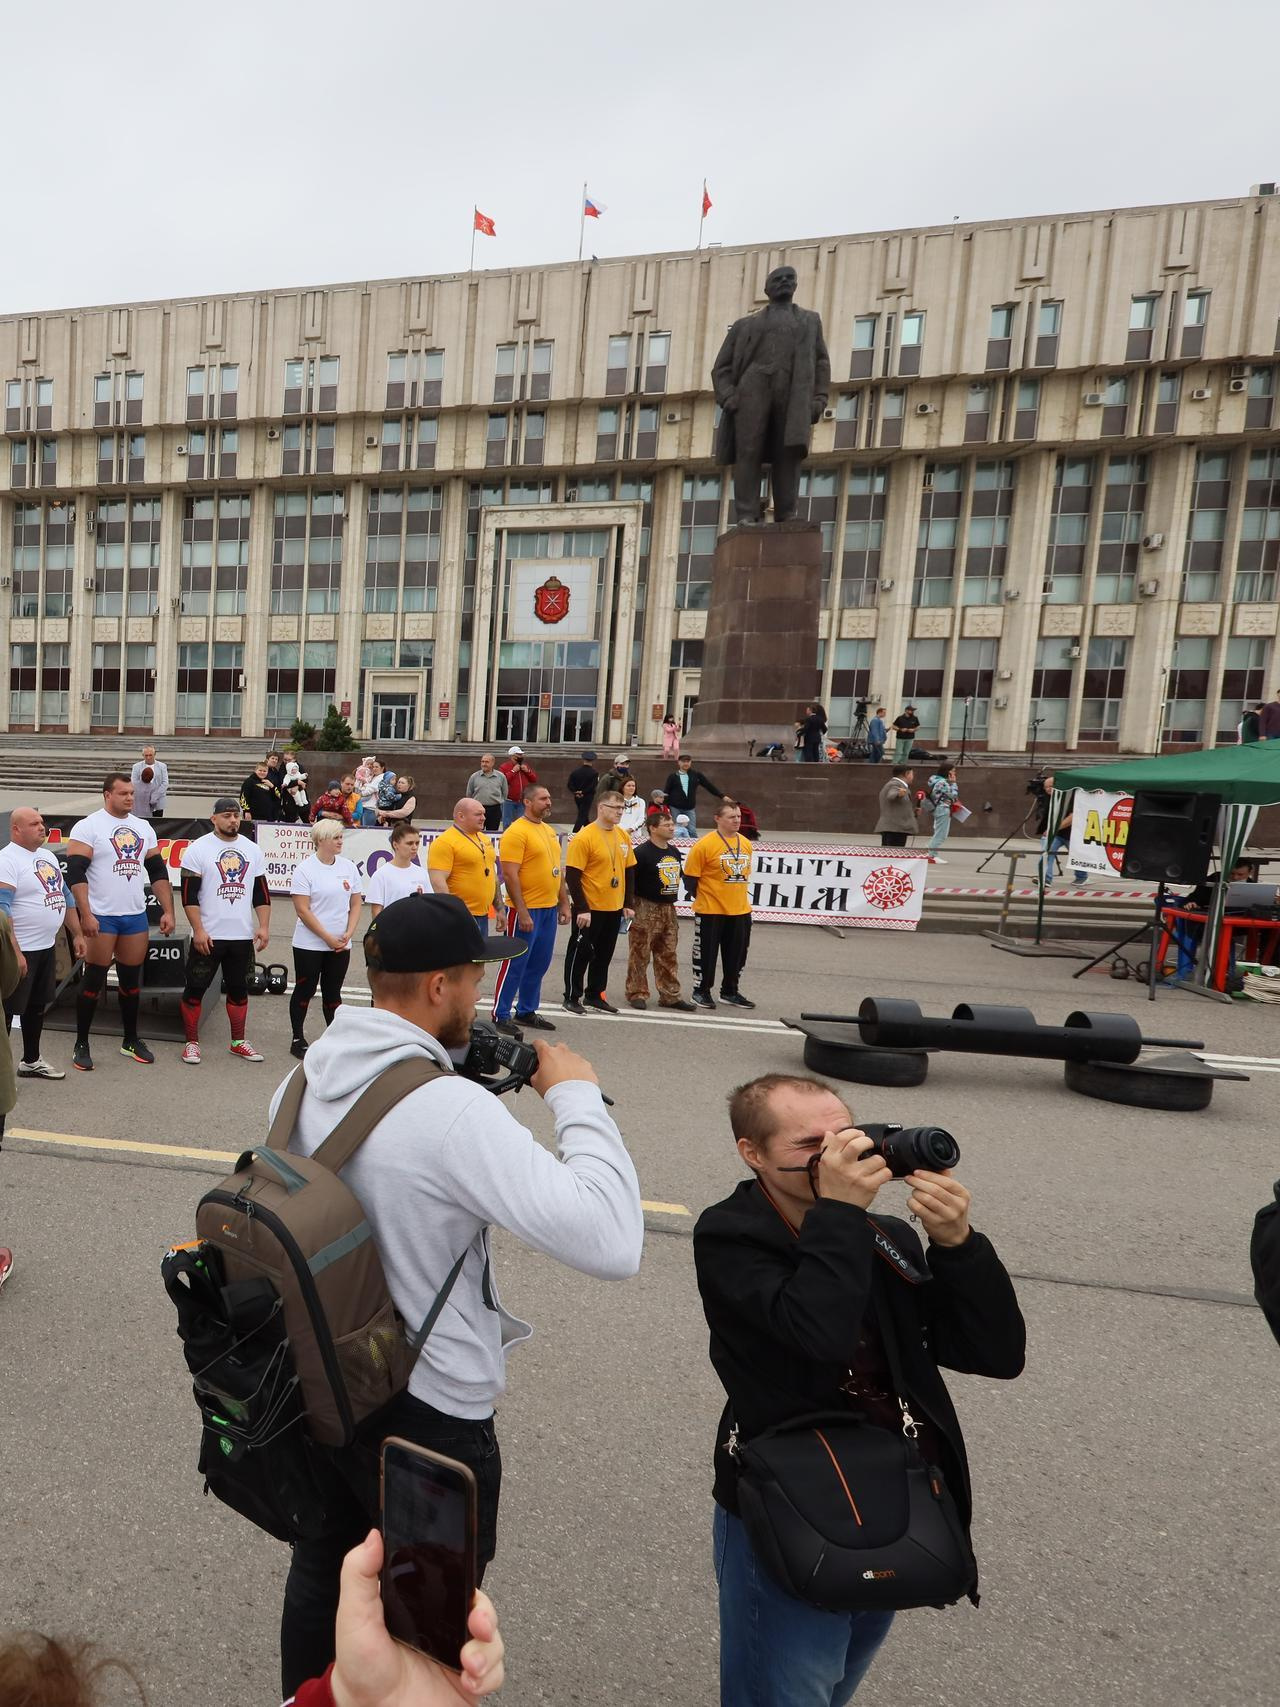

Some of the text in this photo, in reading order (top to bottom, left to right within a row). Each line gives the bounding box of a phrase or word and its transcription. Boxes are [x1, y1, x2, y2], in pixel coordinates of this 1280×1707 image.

[274, 828, 292, 838] 300
[756, 856, 852, 878] БЫТЬ
[149, 947, 181, 960] 240
[271, 977, 281, 985] 24
